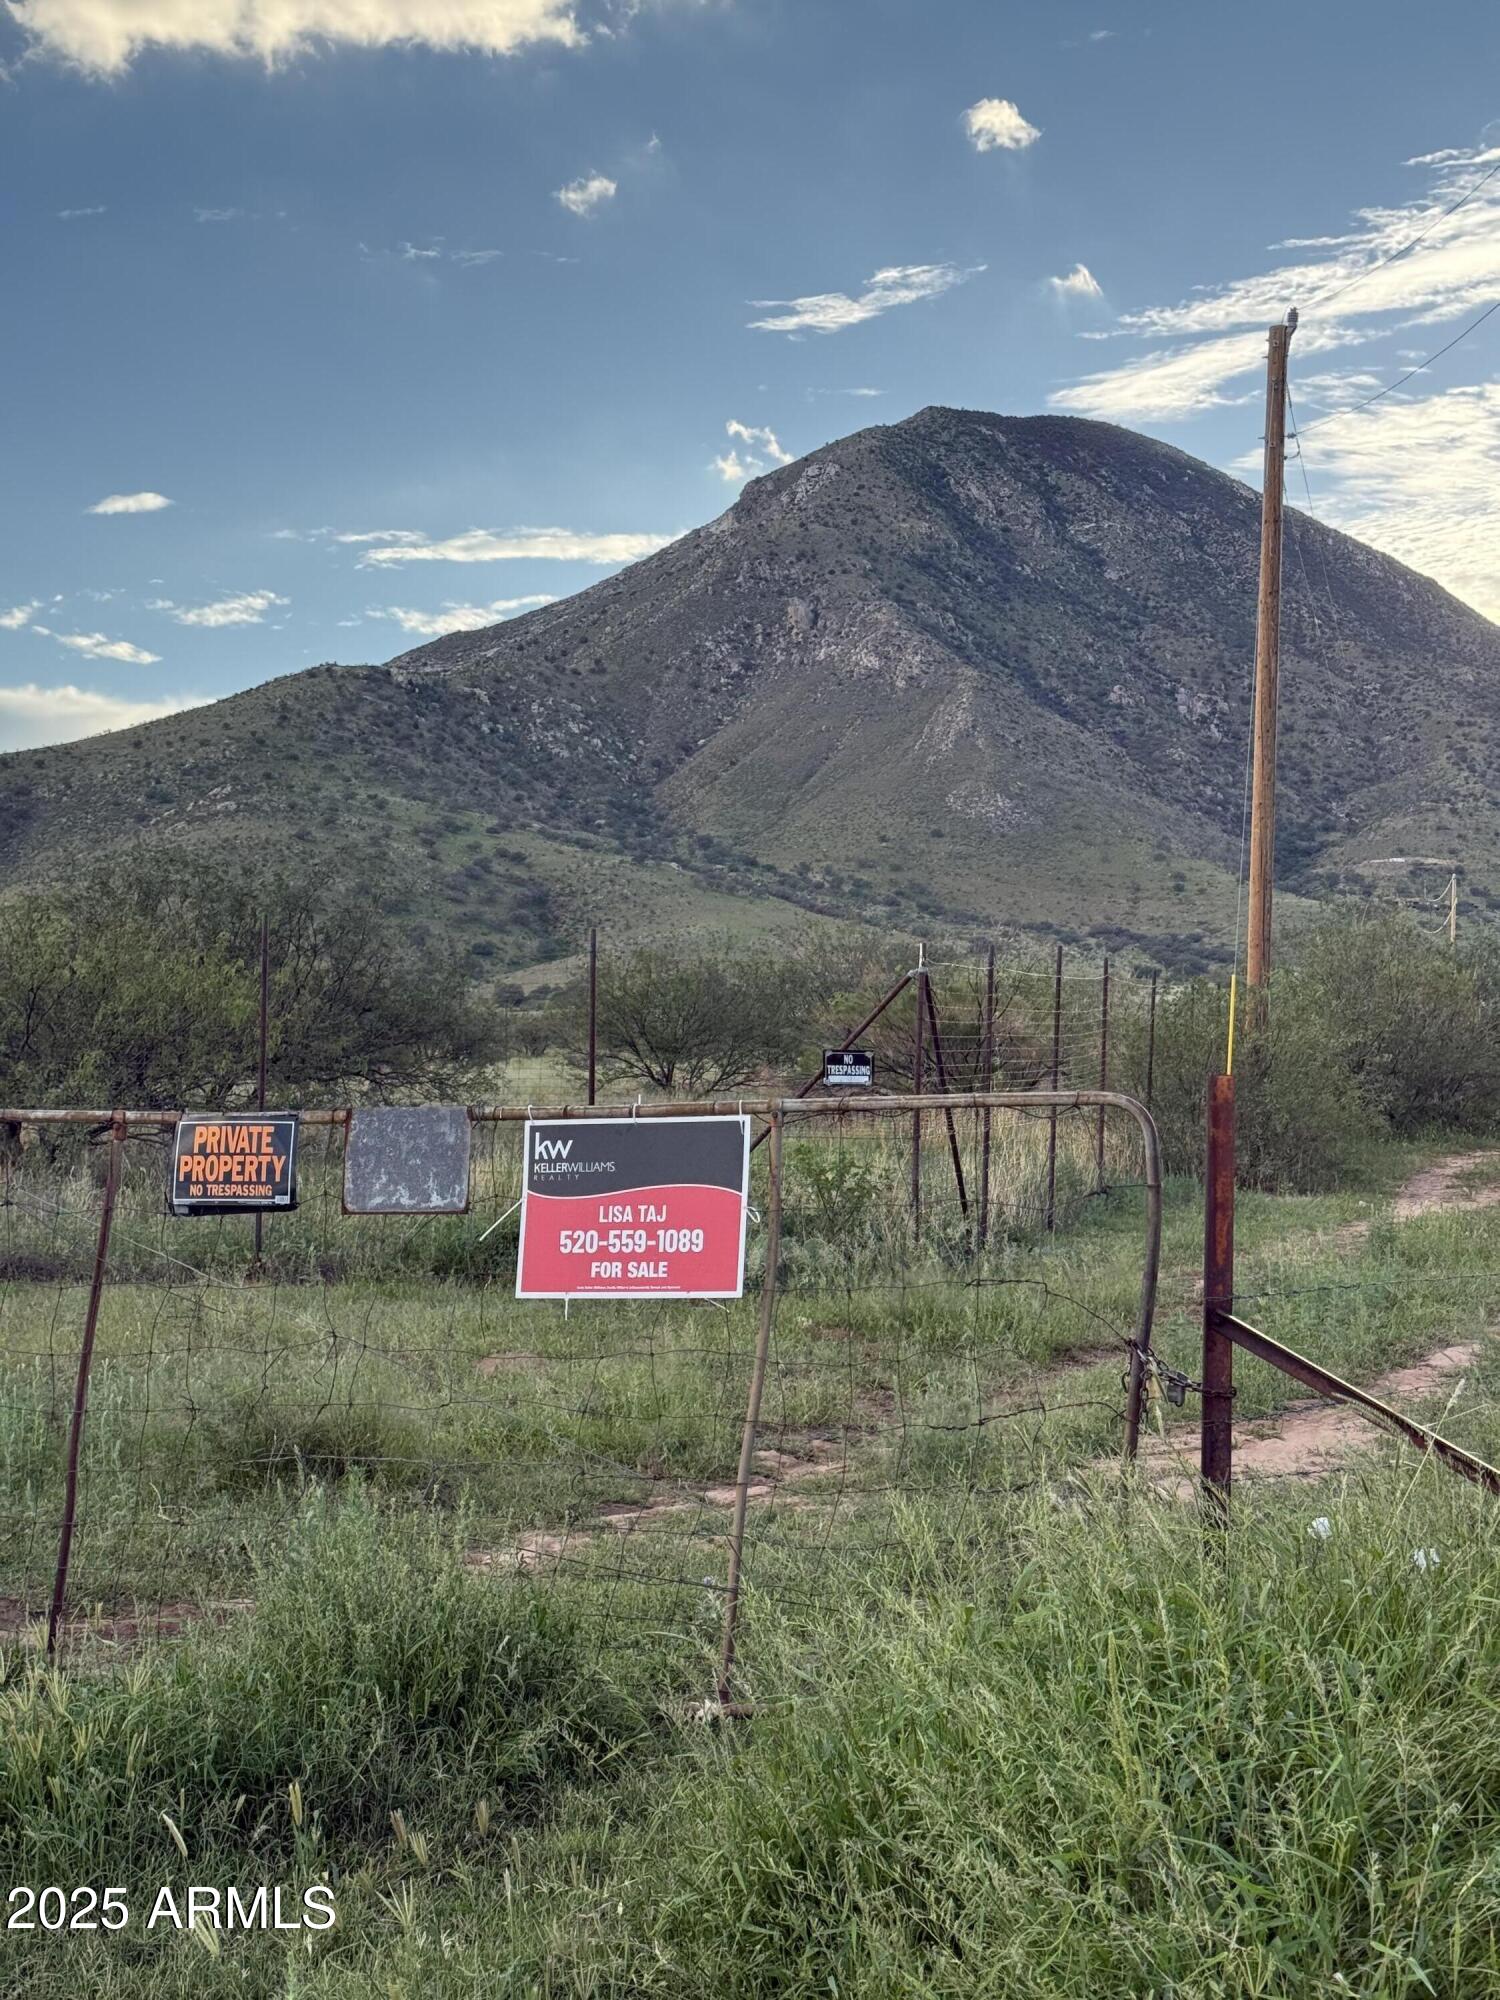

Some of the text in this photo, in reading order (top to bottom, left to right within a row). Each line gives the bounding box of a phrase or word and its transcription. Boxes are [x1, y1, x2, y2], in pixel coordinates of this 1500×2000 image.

[843, 1054, 853, 1065] NO
[827, 1065, 870, 1075] TRESPASSING
[193, 1126, 275, 1154] PRIVATE
[534, 1132, 573, 1160] kw
[178, 1155, 286, 1182] PROPERTY
[189, 1184, 272, 1196] NO TRESPASSING
[599, 1204, 668, 1223] LISA TAJ
[560, 1229, 704, 1254] 520-559-1089
[590, 1261, 669, 1278] FOR SALE
